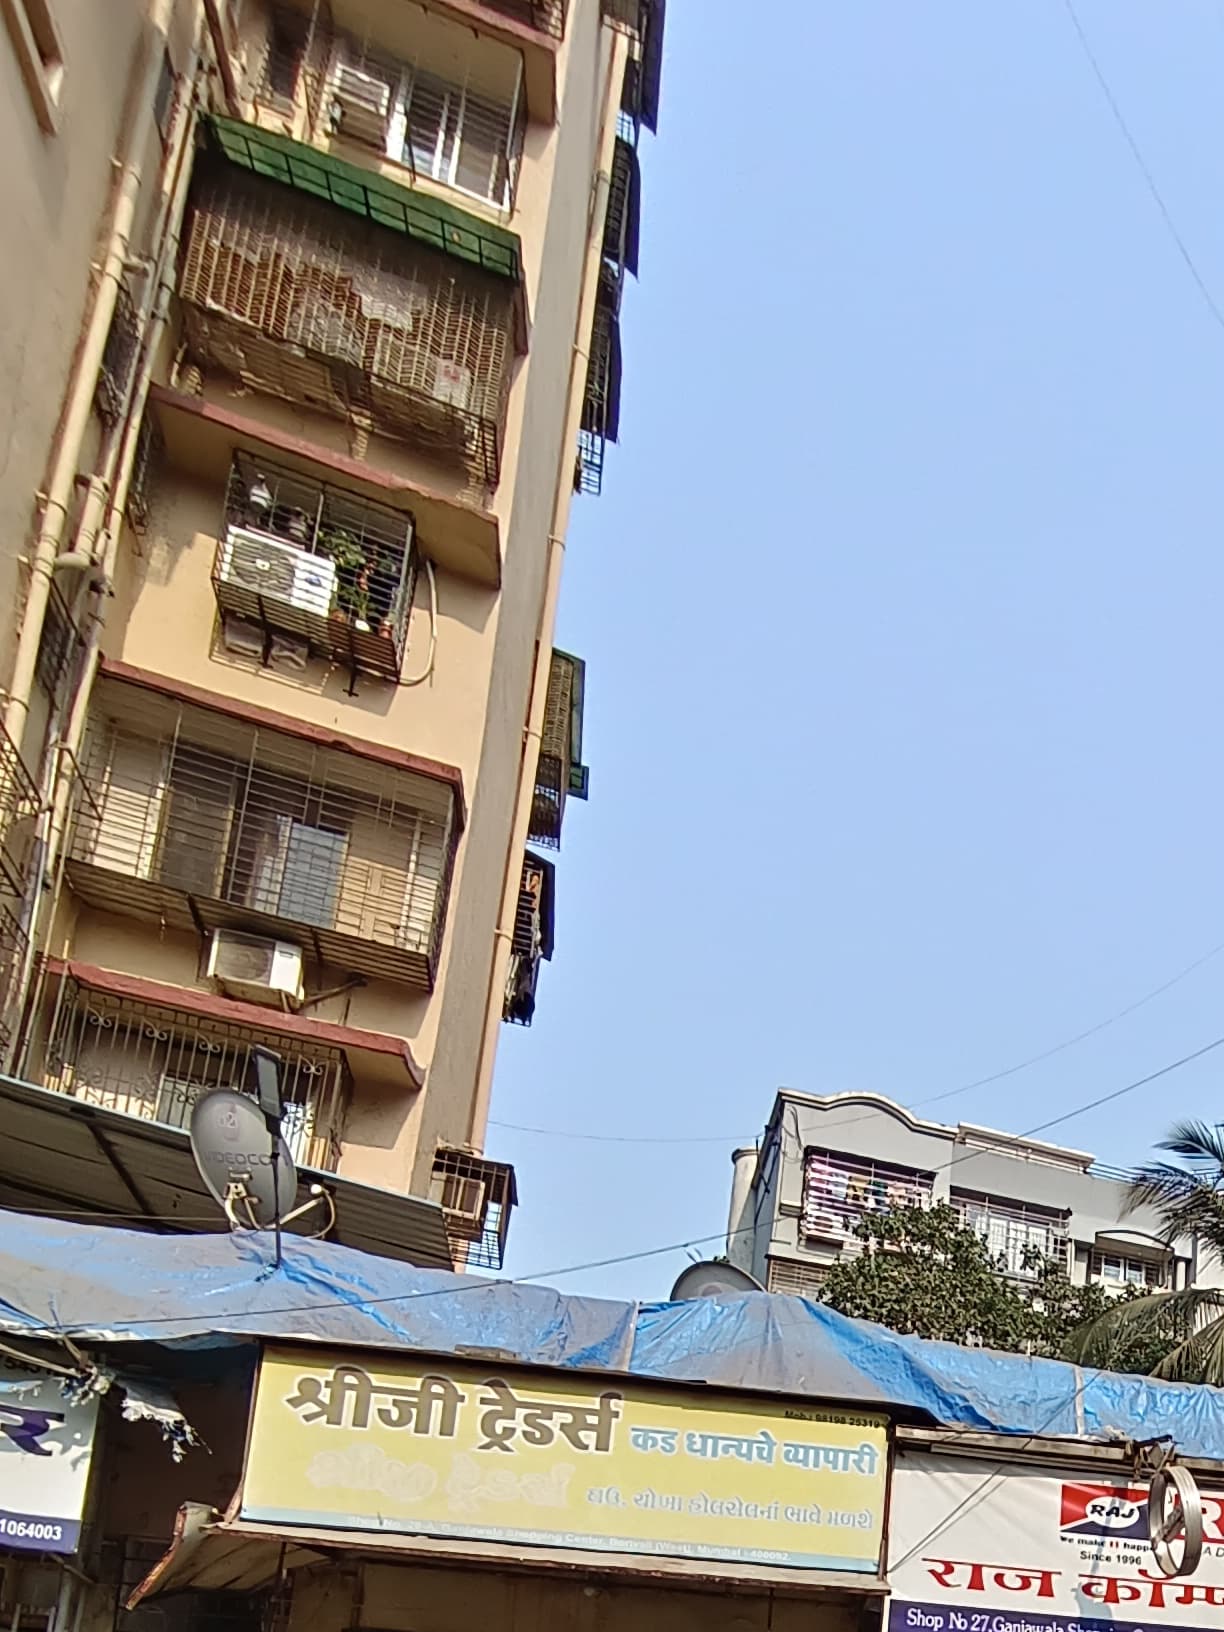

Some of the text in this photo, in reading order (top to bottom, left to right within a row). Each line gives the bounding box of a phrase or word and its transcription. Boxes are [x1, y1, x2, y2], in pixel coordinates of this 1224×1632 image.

[286, 1366, 622, 1452] श्रीजी ट्रेडर्स
[685, 1431, 777, 1464] धान्यचे
[783, 1443, 879, 1475] व्यापारी
[1089, 1503, 1136, 1520] RAJ
[1079, 1551, 1142, 1566] Since 1996
[922, 1557, 1062, 1598] राज
[906, 1607, 944, 1632] Shop
